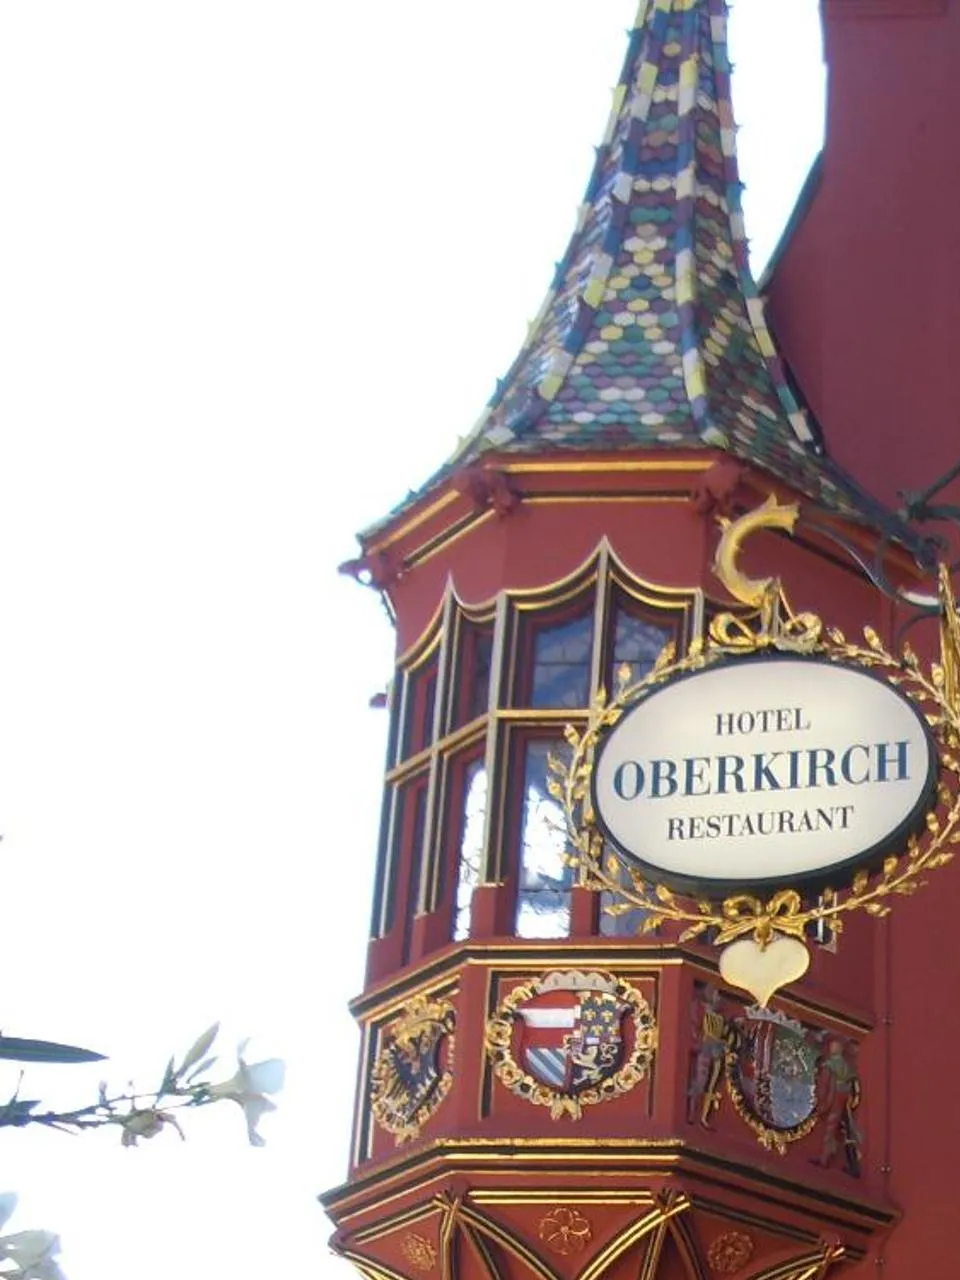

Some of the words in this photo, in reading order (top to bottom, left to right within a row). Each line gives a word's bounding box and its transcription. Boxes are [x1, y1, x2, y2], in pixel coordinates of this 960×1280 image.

[715, 707, 811, 736] HOTEL
[612, 741, 911, 801] OBERKIRCH
[667, 805, 854, 841] RESTAURANT
